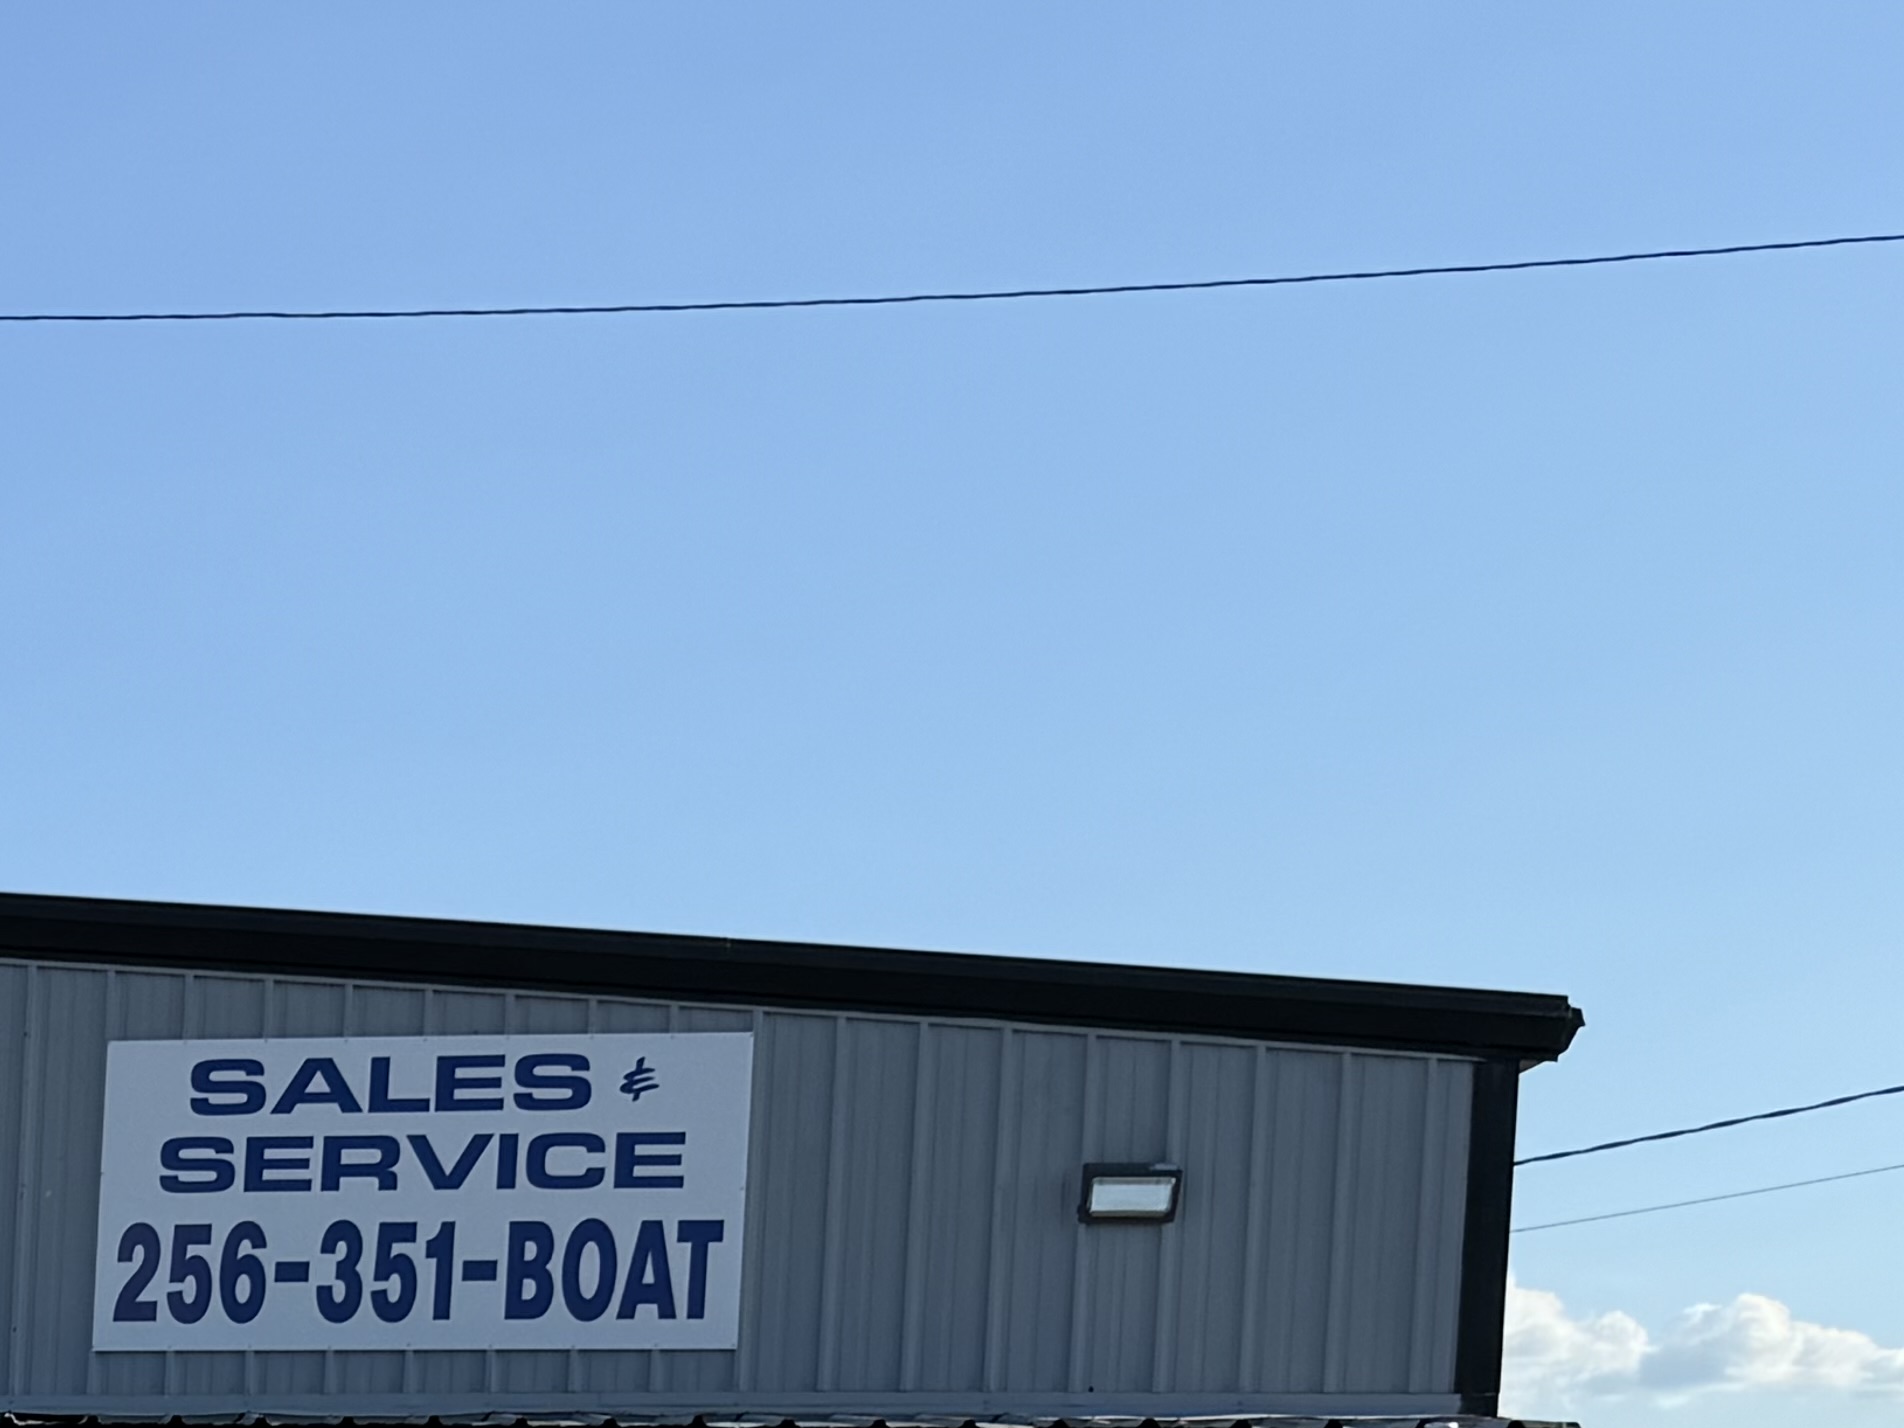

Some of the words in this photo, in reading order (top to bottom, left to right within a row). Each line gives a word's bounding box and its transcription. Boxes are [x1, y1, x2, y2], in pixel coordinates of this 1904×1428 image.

[189, 1053, 592, 1117] SALES
[619, 1056, 660, 1101] &
[158, 1131, 687, 1194] SERVICE
[112, 1217, 725, 1325] 256-351-BOAT
